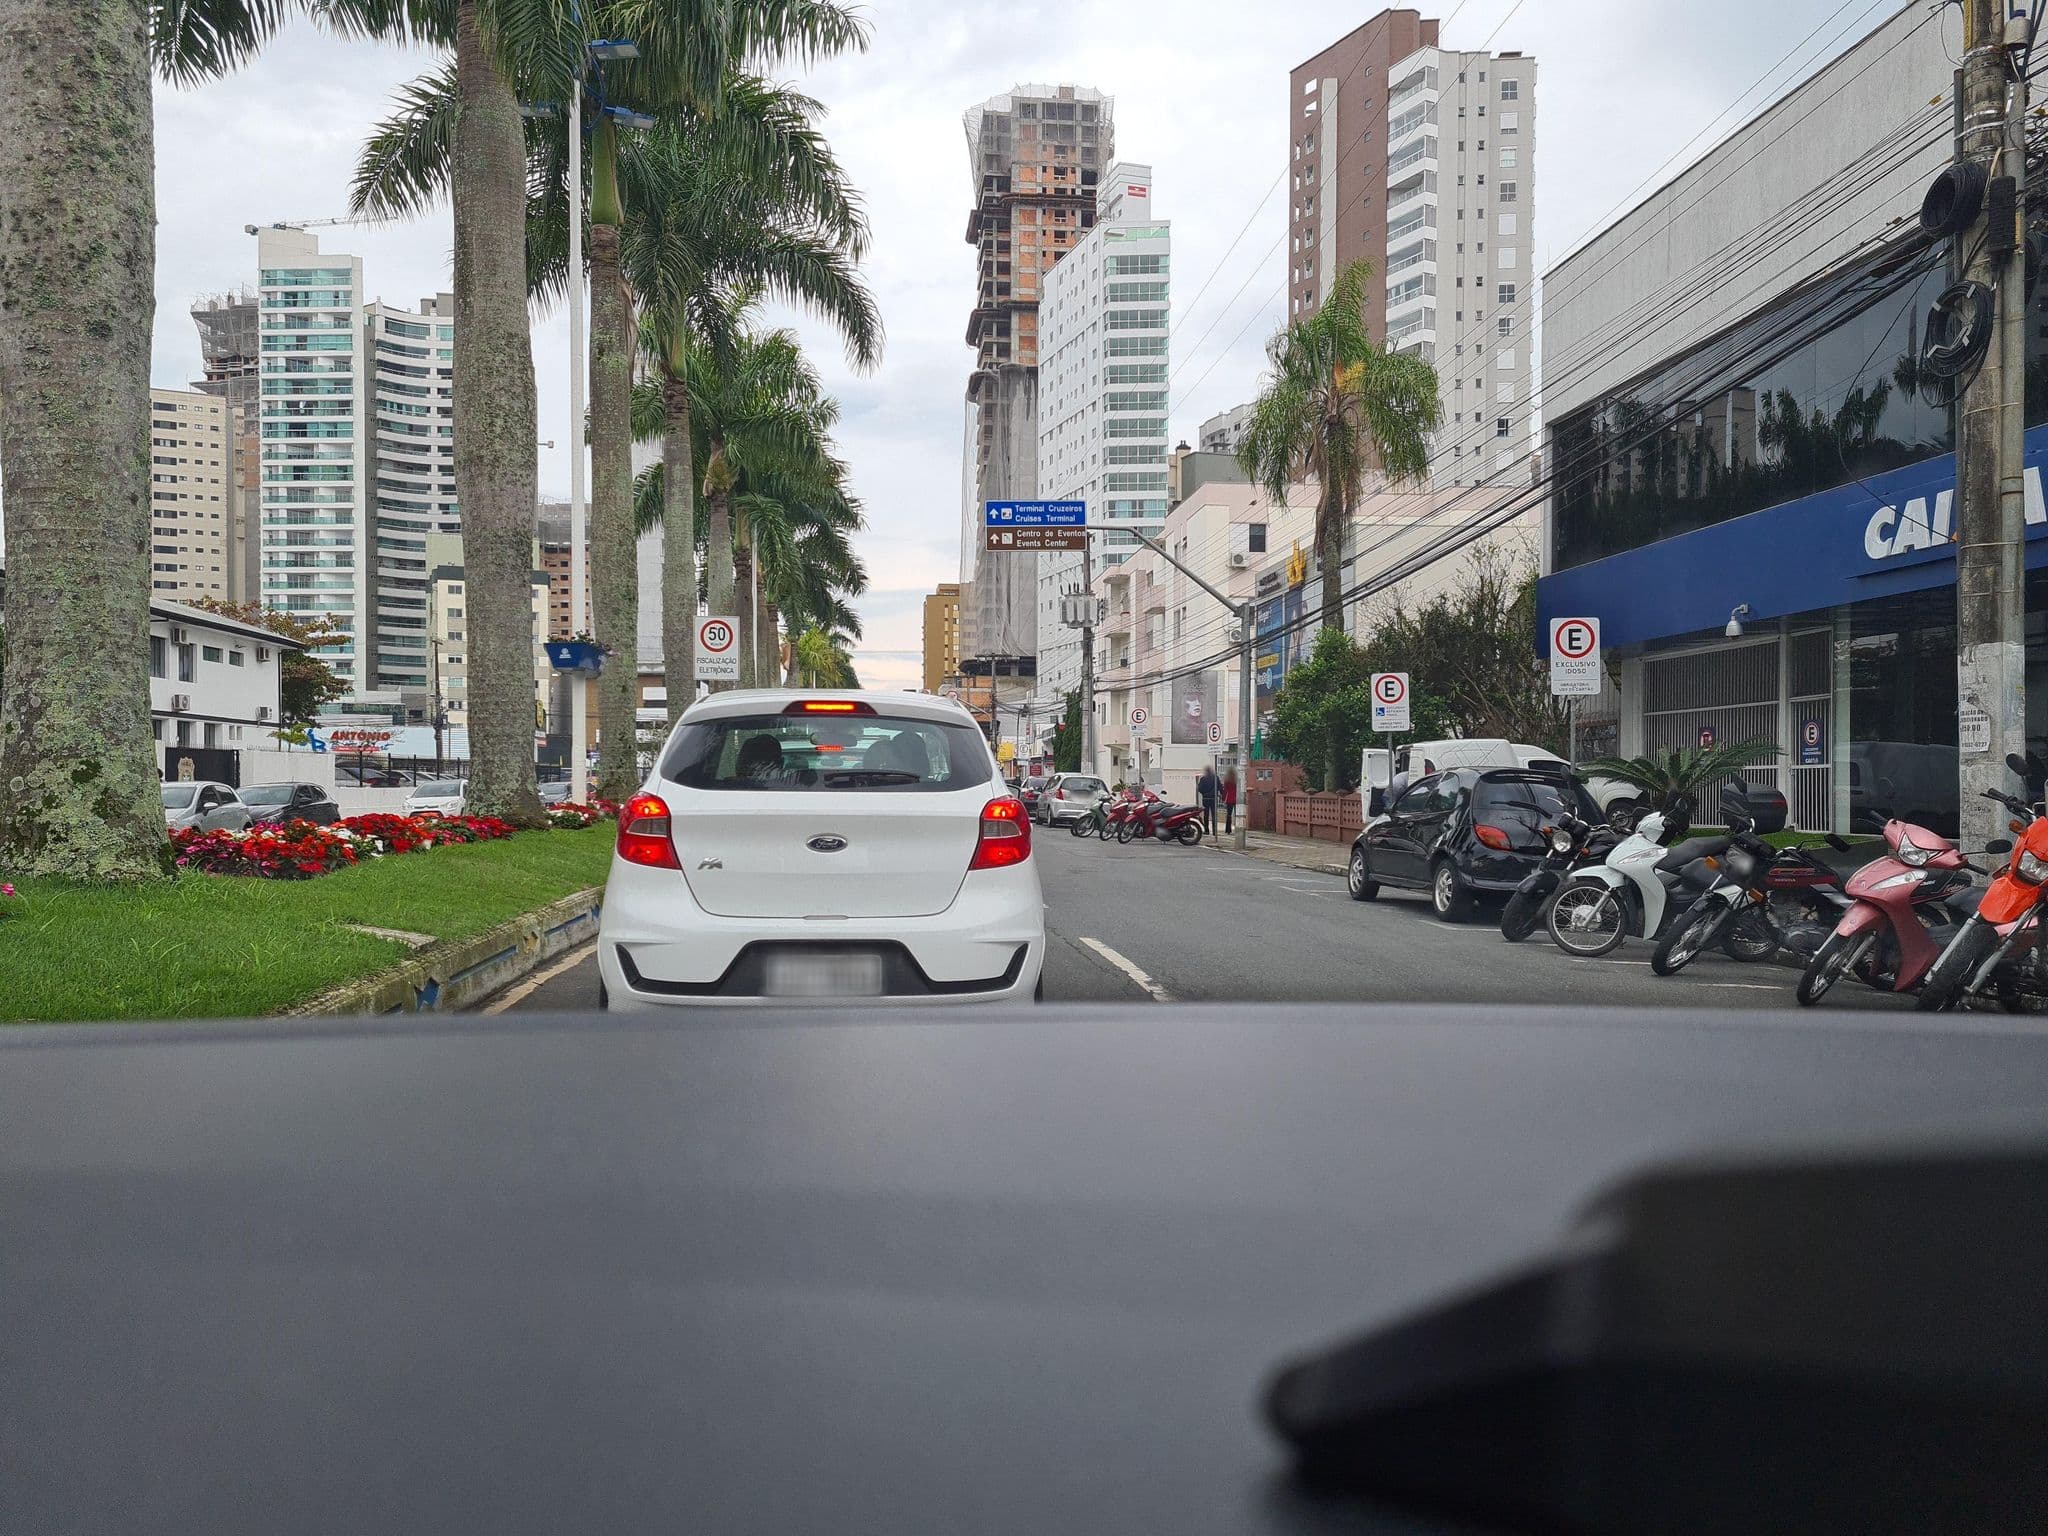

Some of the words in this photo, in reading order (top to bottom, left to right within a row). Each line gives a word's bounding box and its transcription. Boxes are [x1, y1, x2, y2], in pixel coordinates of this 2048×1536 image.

[1015, 504, 1045, 513] Terminal
[1048, 504, 1083, 513] Cruzeiros
[1015, 514, 1042, 522] Cruises
[1045, 514, 1076, 522] Terminal
[1016, 529, 1041, 537] Centro
[1044, 529, 1054, 537] de
[1057, 529, 1086, 537] Eventos
[1016, 539, 1041, 547] Events
[708, 626, 726, 641] 50
[1568, 628, 1582, 650] E
[696, 656, 737, 665] FISCALIZAÇÃO
[699, 665, 735, 674] ELETRÔNICA
[1384, 680, 1395, 697] E
[1136, 711, 1142, 720] E
[1212, 727, 1217, 738] E
[1808, 726, 1815, 741] E
